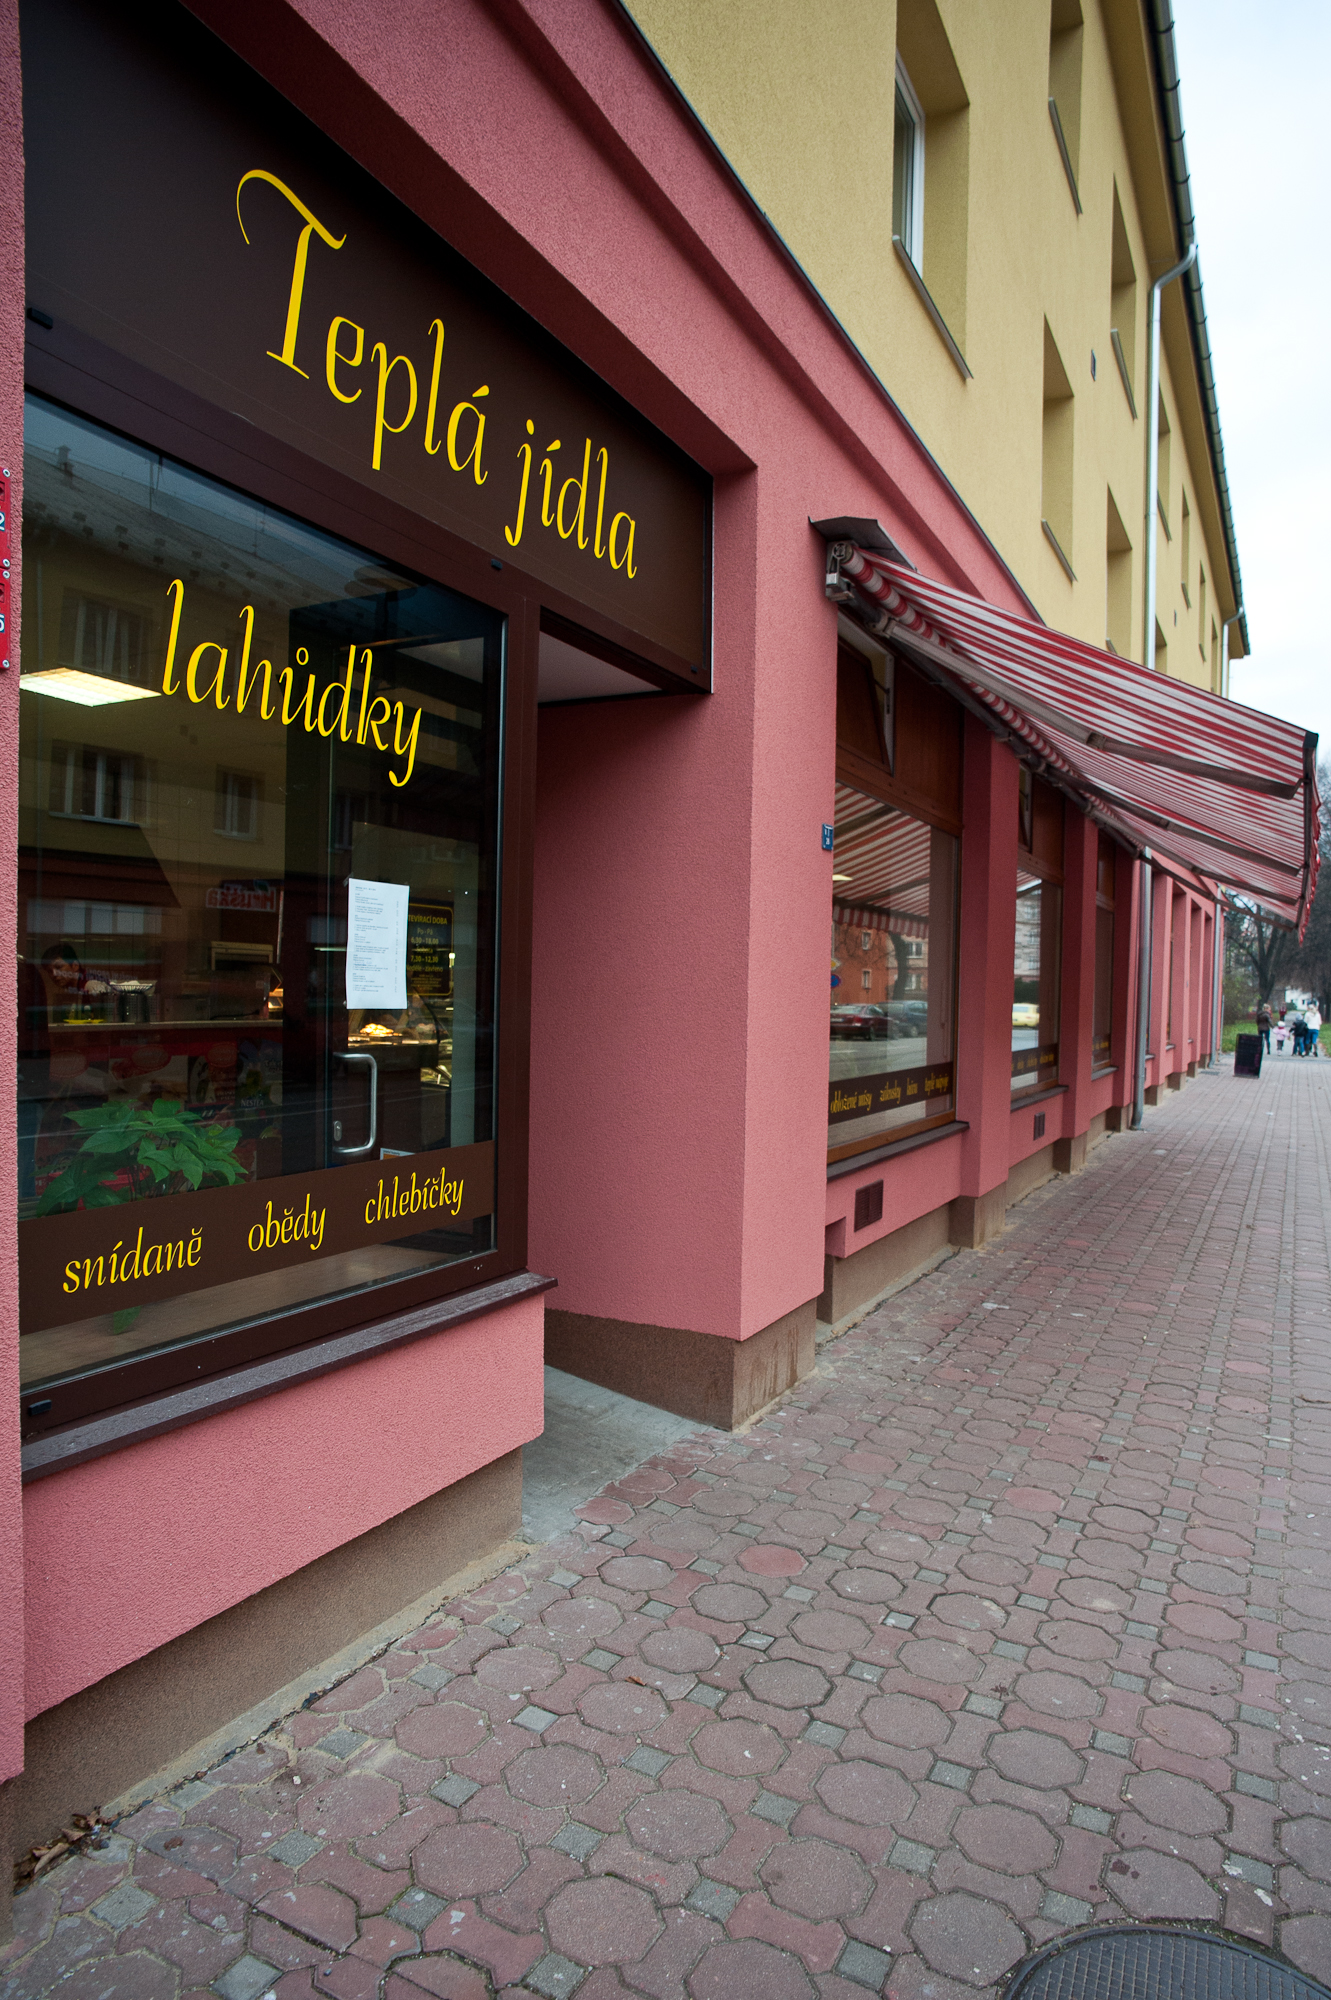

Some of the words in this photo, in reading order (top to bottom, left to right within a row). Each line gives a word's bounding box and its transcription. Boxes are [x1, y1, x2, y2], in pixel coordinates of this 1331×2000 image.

[237, 170, 489, 486] Teplá
[504, 418, 637, 579] jídla
[162, 578, 422, 787] lahůdky
[408, 914, 432, 924] TEVÍRACÍ
[433, 916, 447, 925] DOBA
[241, 1098, 264, 1107] NESTEA
[63, 1227, 203, 1294] snídaně
[248, 1194, 326, 1251] obědy
[365, 1167, 464, 1225] chlebíčky
